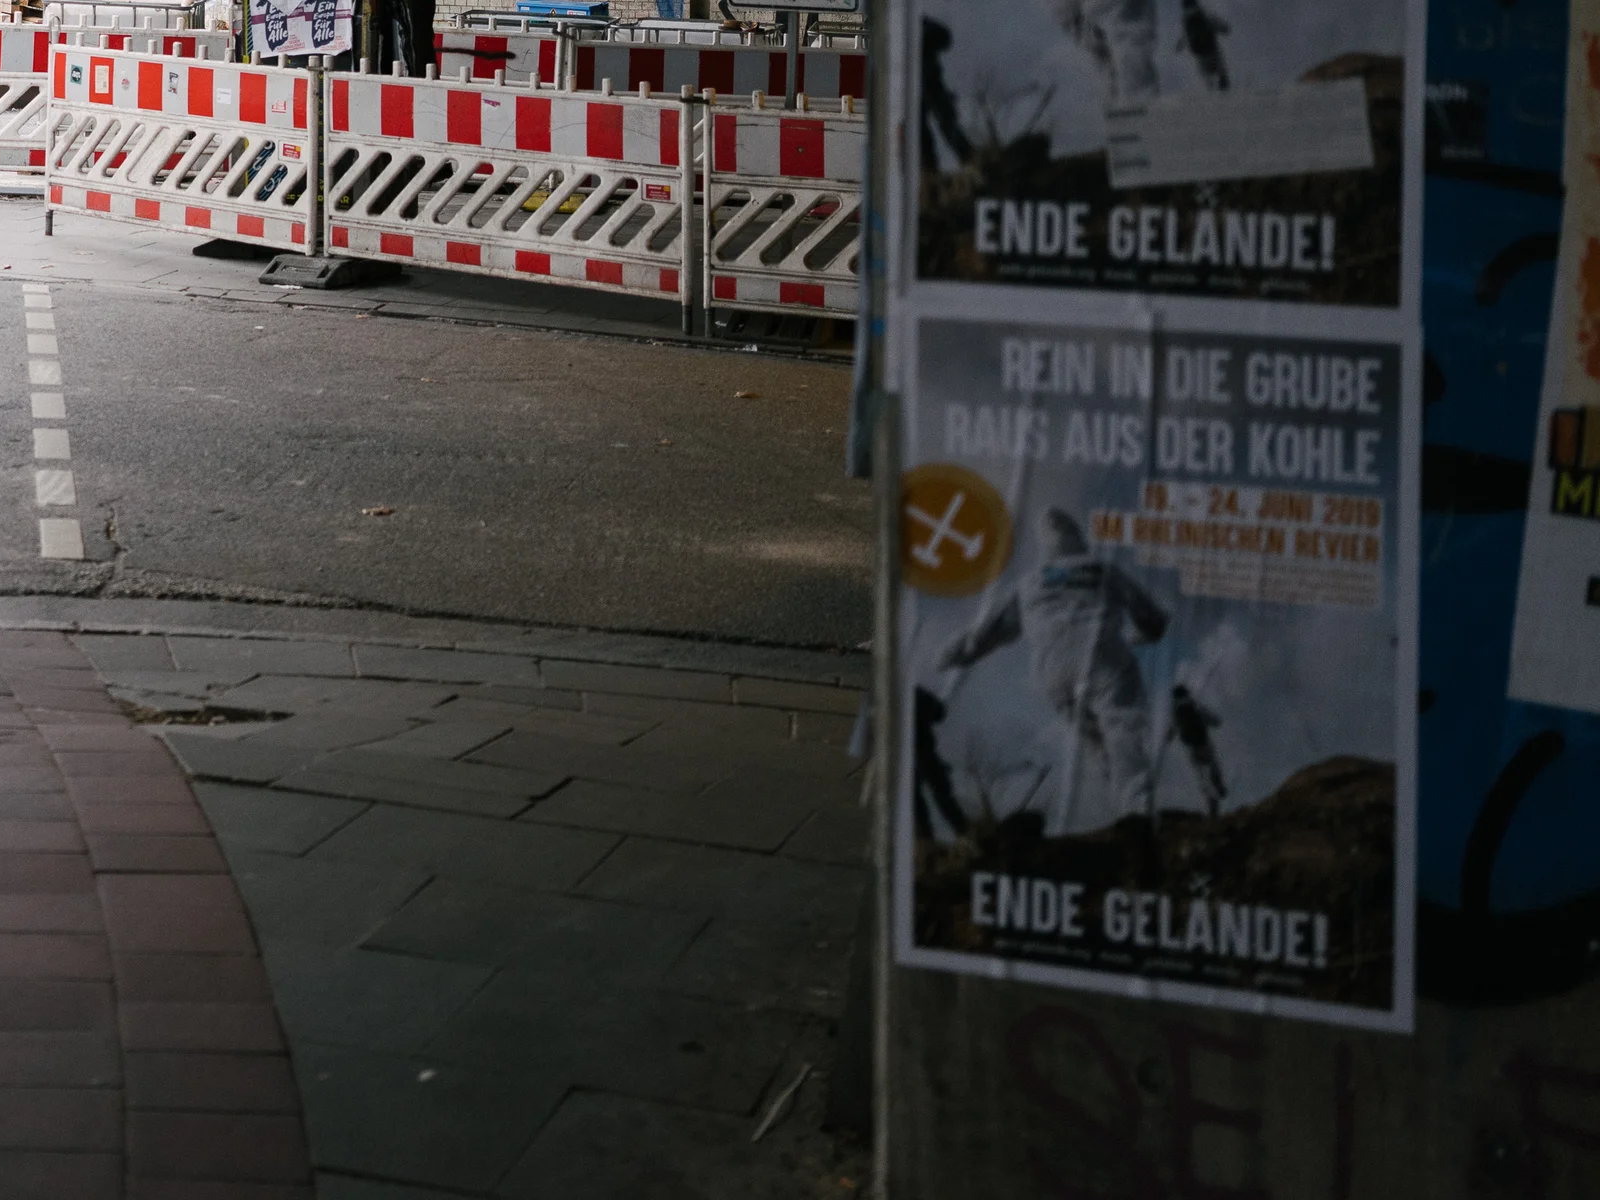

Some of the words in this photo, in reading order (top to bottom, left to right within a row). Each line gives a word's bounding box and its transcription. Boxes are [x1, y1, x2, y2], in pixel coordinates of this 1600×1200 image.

[973, 199, 1091, 261] ENDE
[1001, 338, 1097, 397] REIN
[1108, 342, 1154, 399] IN
[1164, 347, 1233, 404] DIE
[1244, 352, 1383, 415] GRUBE
[945, 403, 1050, 460] RAUS
[1062, 409, 1145, 468] AUS
[1154, 417, 1235, 475] DER
[1248, 421, 1382, 485] KOHLE
[969, 870, 1087, 939] ENDE
